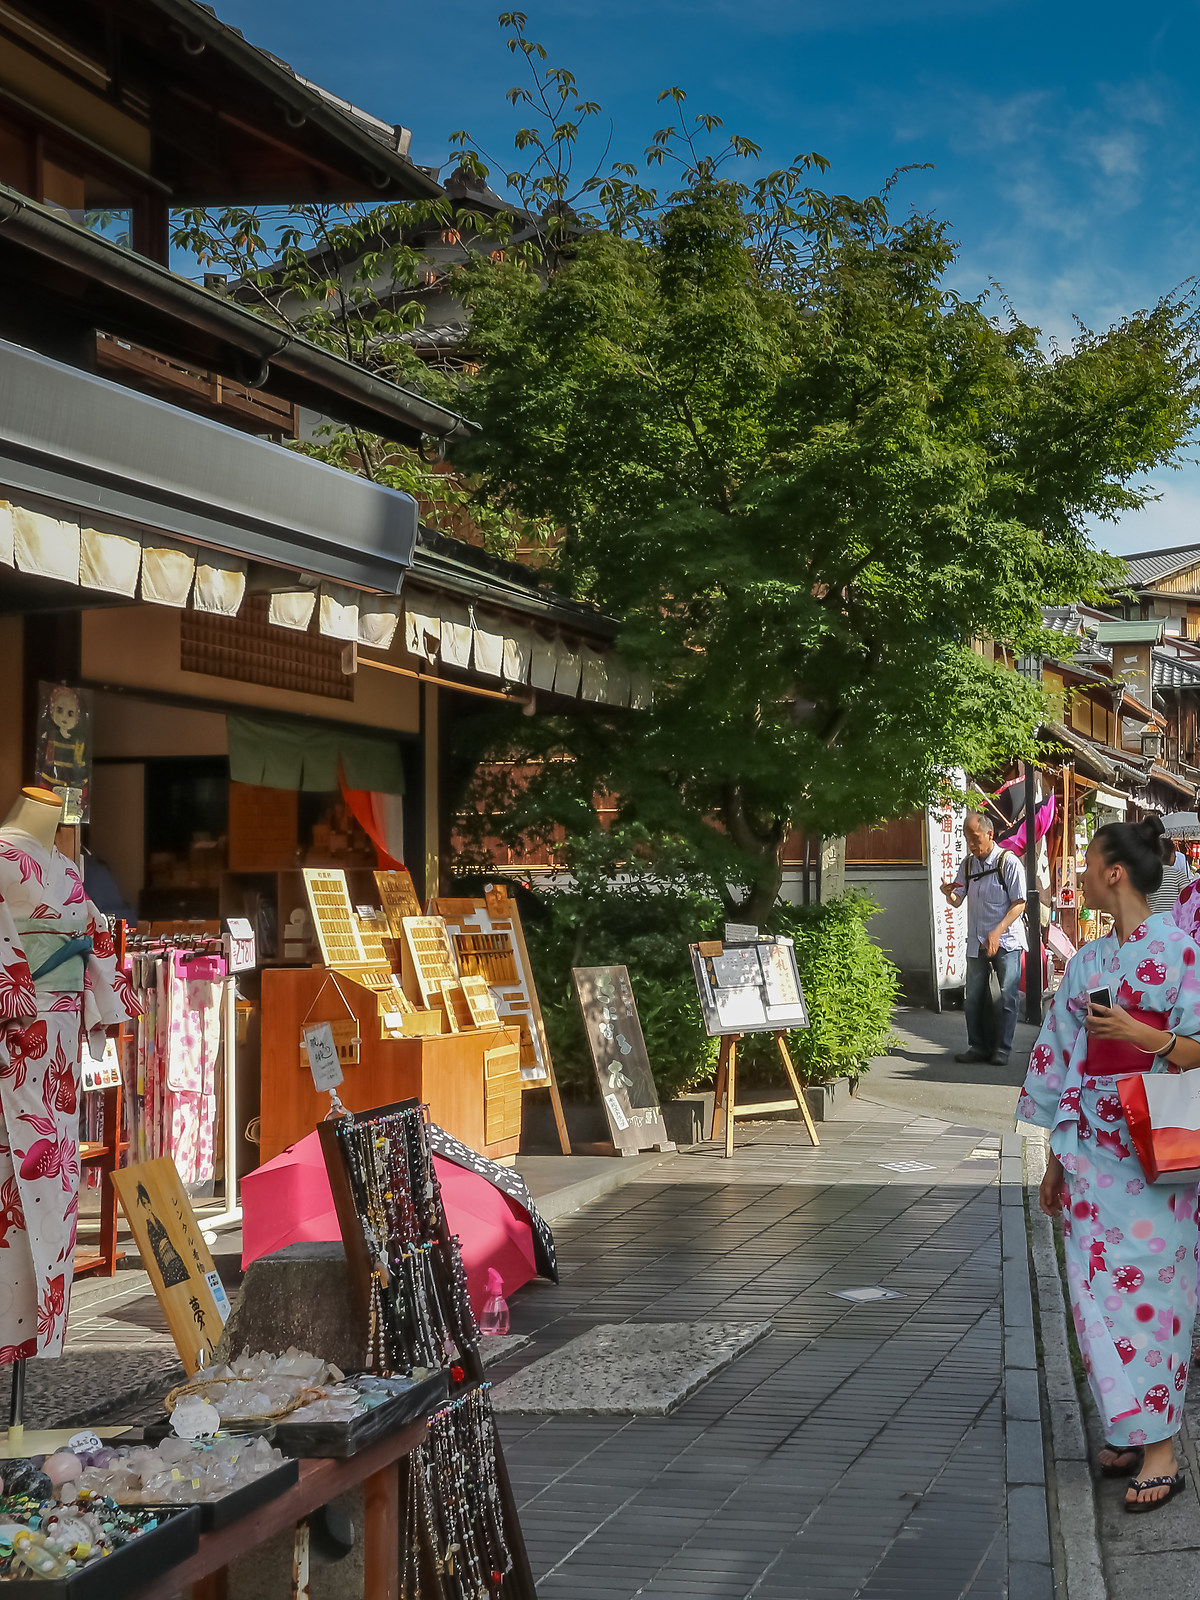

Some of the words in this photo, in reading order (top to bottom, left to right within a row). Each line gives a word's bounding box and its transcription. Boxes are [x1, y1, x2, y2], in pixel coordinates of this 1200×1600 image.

[939, 777, 957, 976] 通り抜けきません
[171, 1196, 206, 1276] レンタル着物
